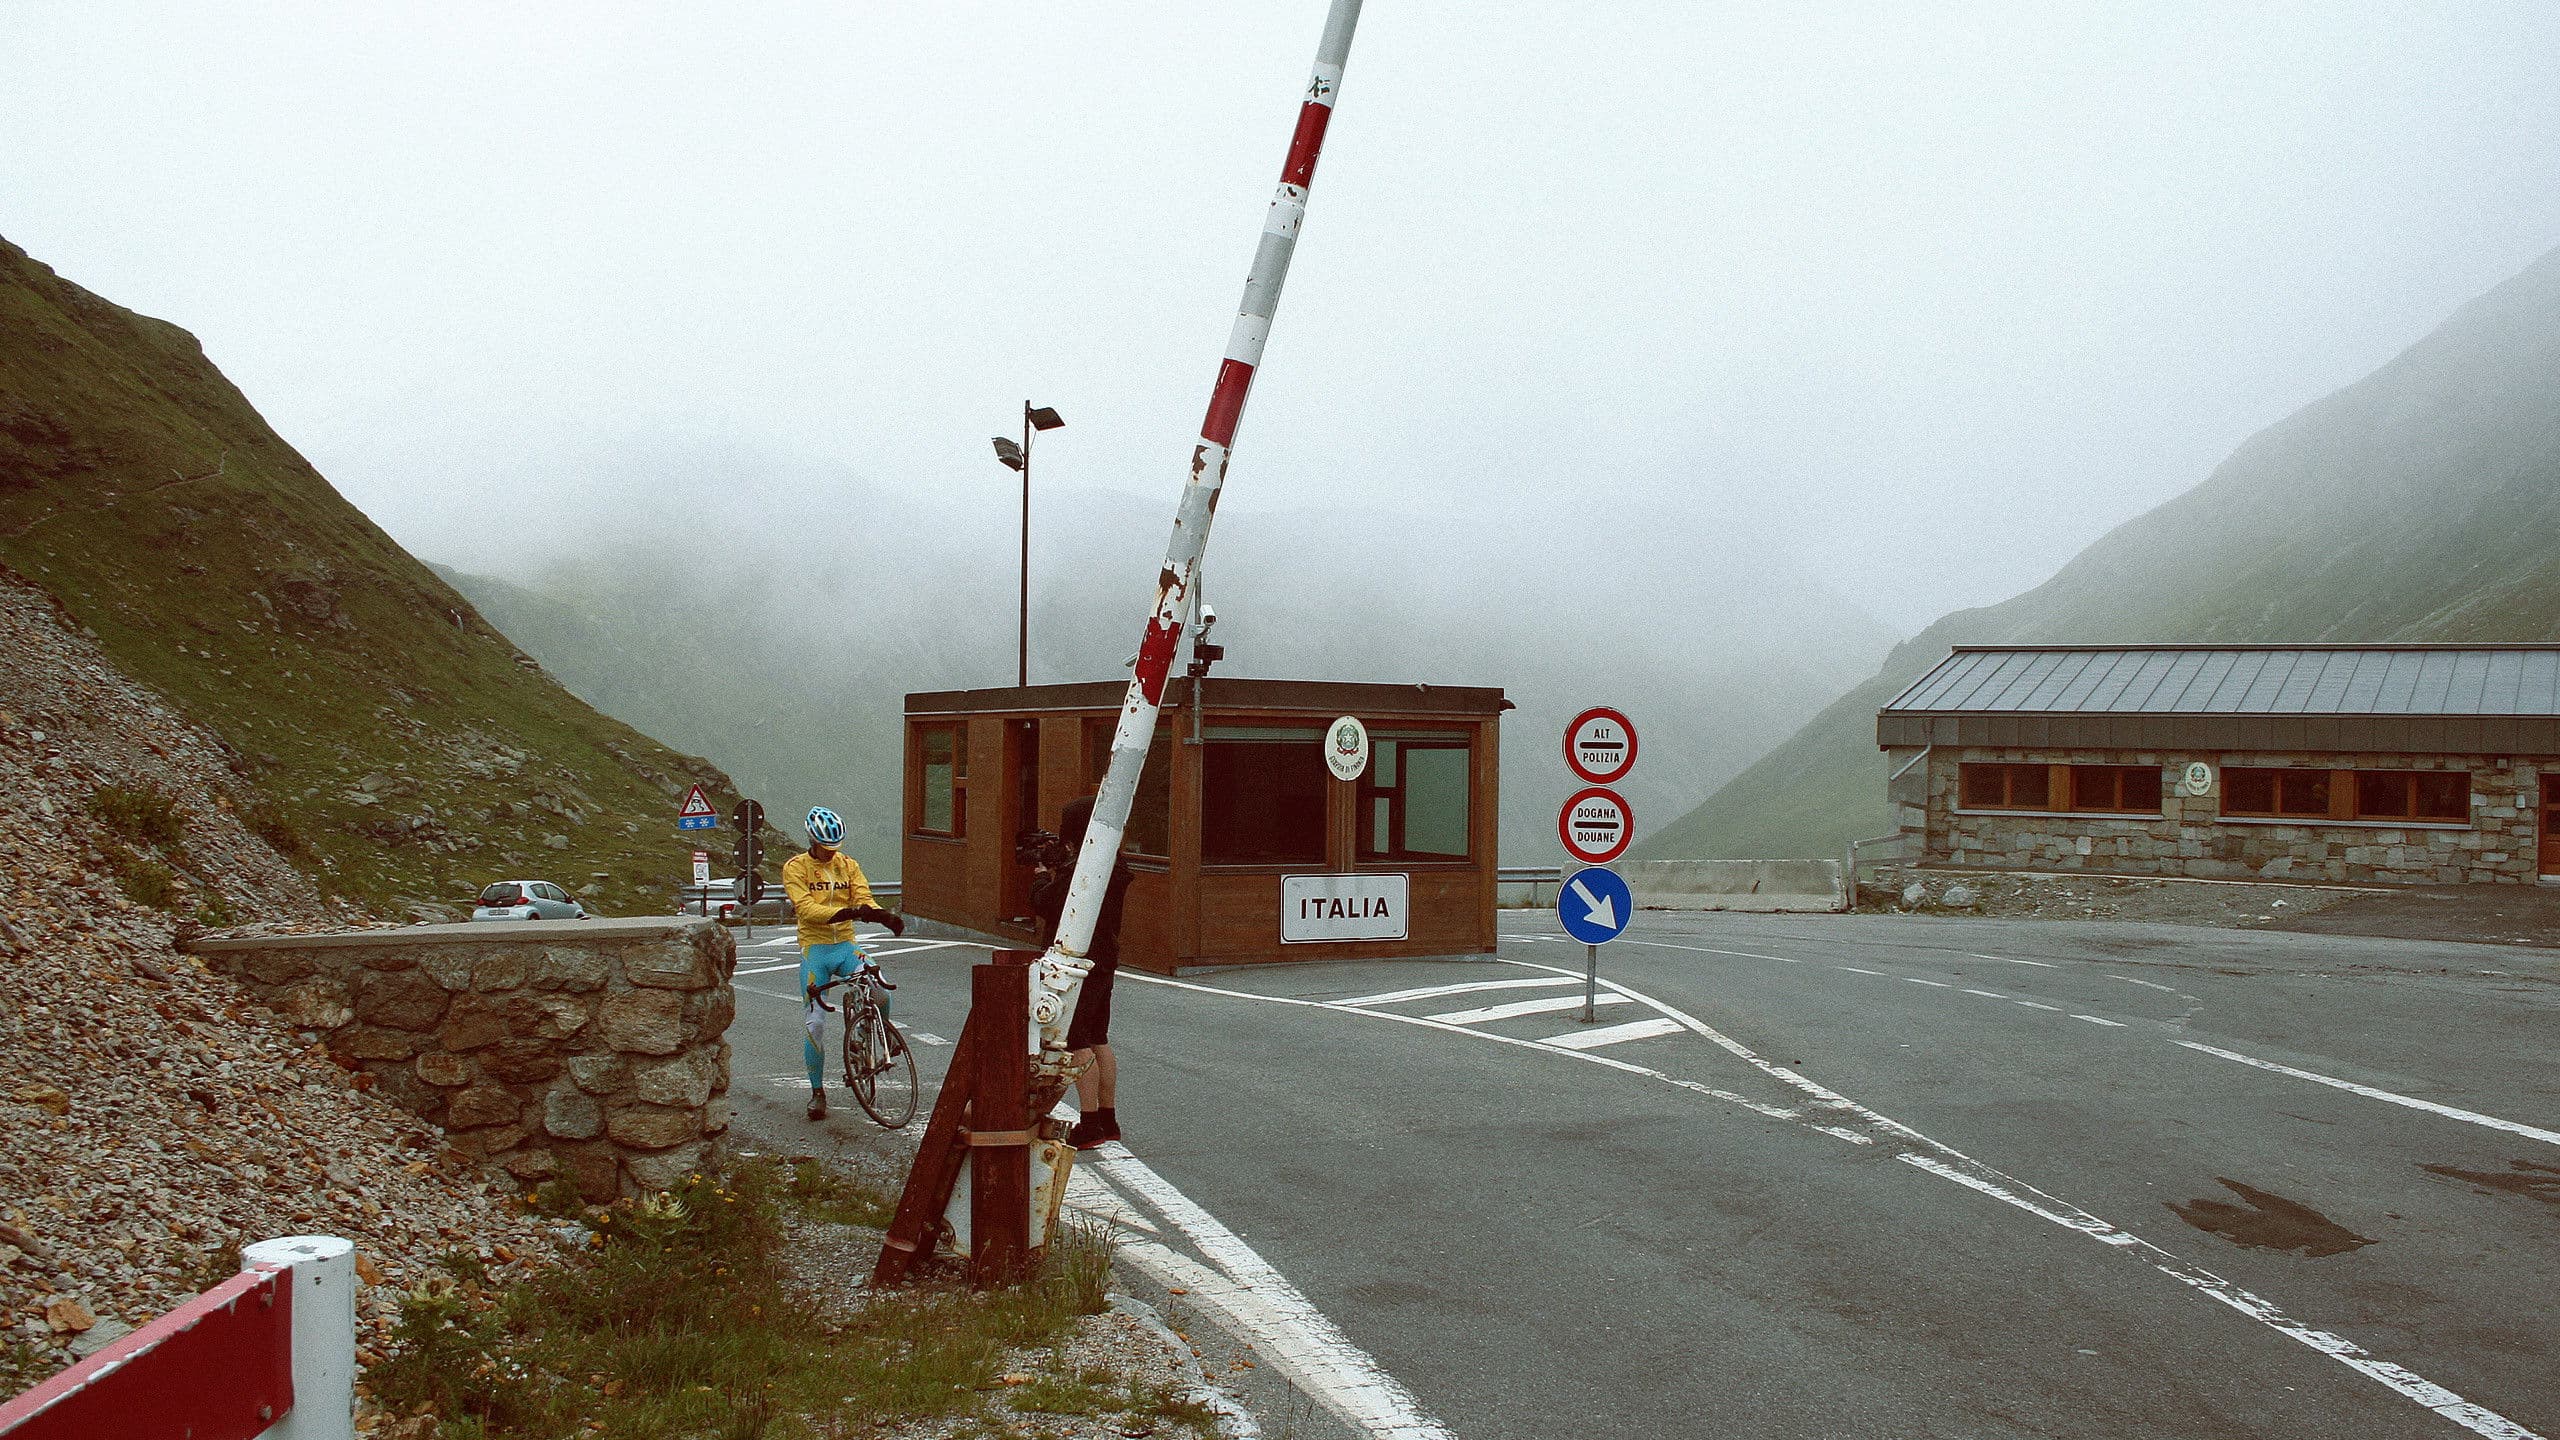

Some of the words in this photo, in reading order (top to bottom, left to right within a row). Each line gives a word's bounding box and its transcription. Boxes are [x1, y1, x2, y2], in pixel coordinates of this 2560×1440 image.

[1593, 728, 1610, 739] ALT
[1583, 752, 1620, 763] POLIZIA
[1577, 807, 1617, 819] DOGANA
[1577, 831, 1616, 843] DOUANE
[1301, 897, 1390, 920] ITALIA
